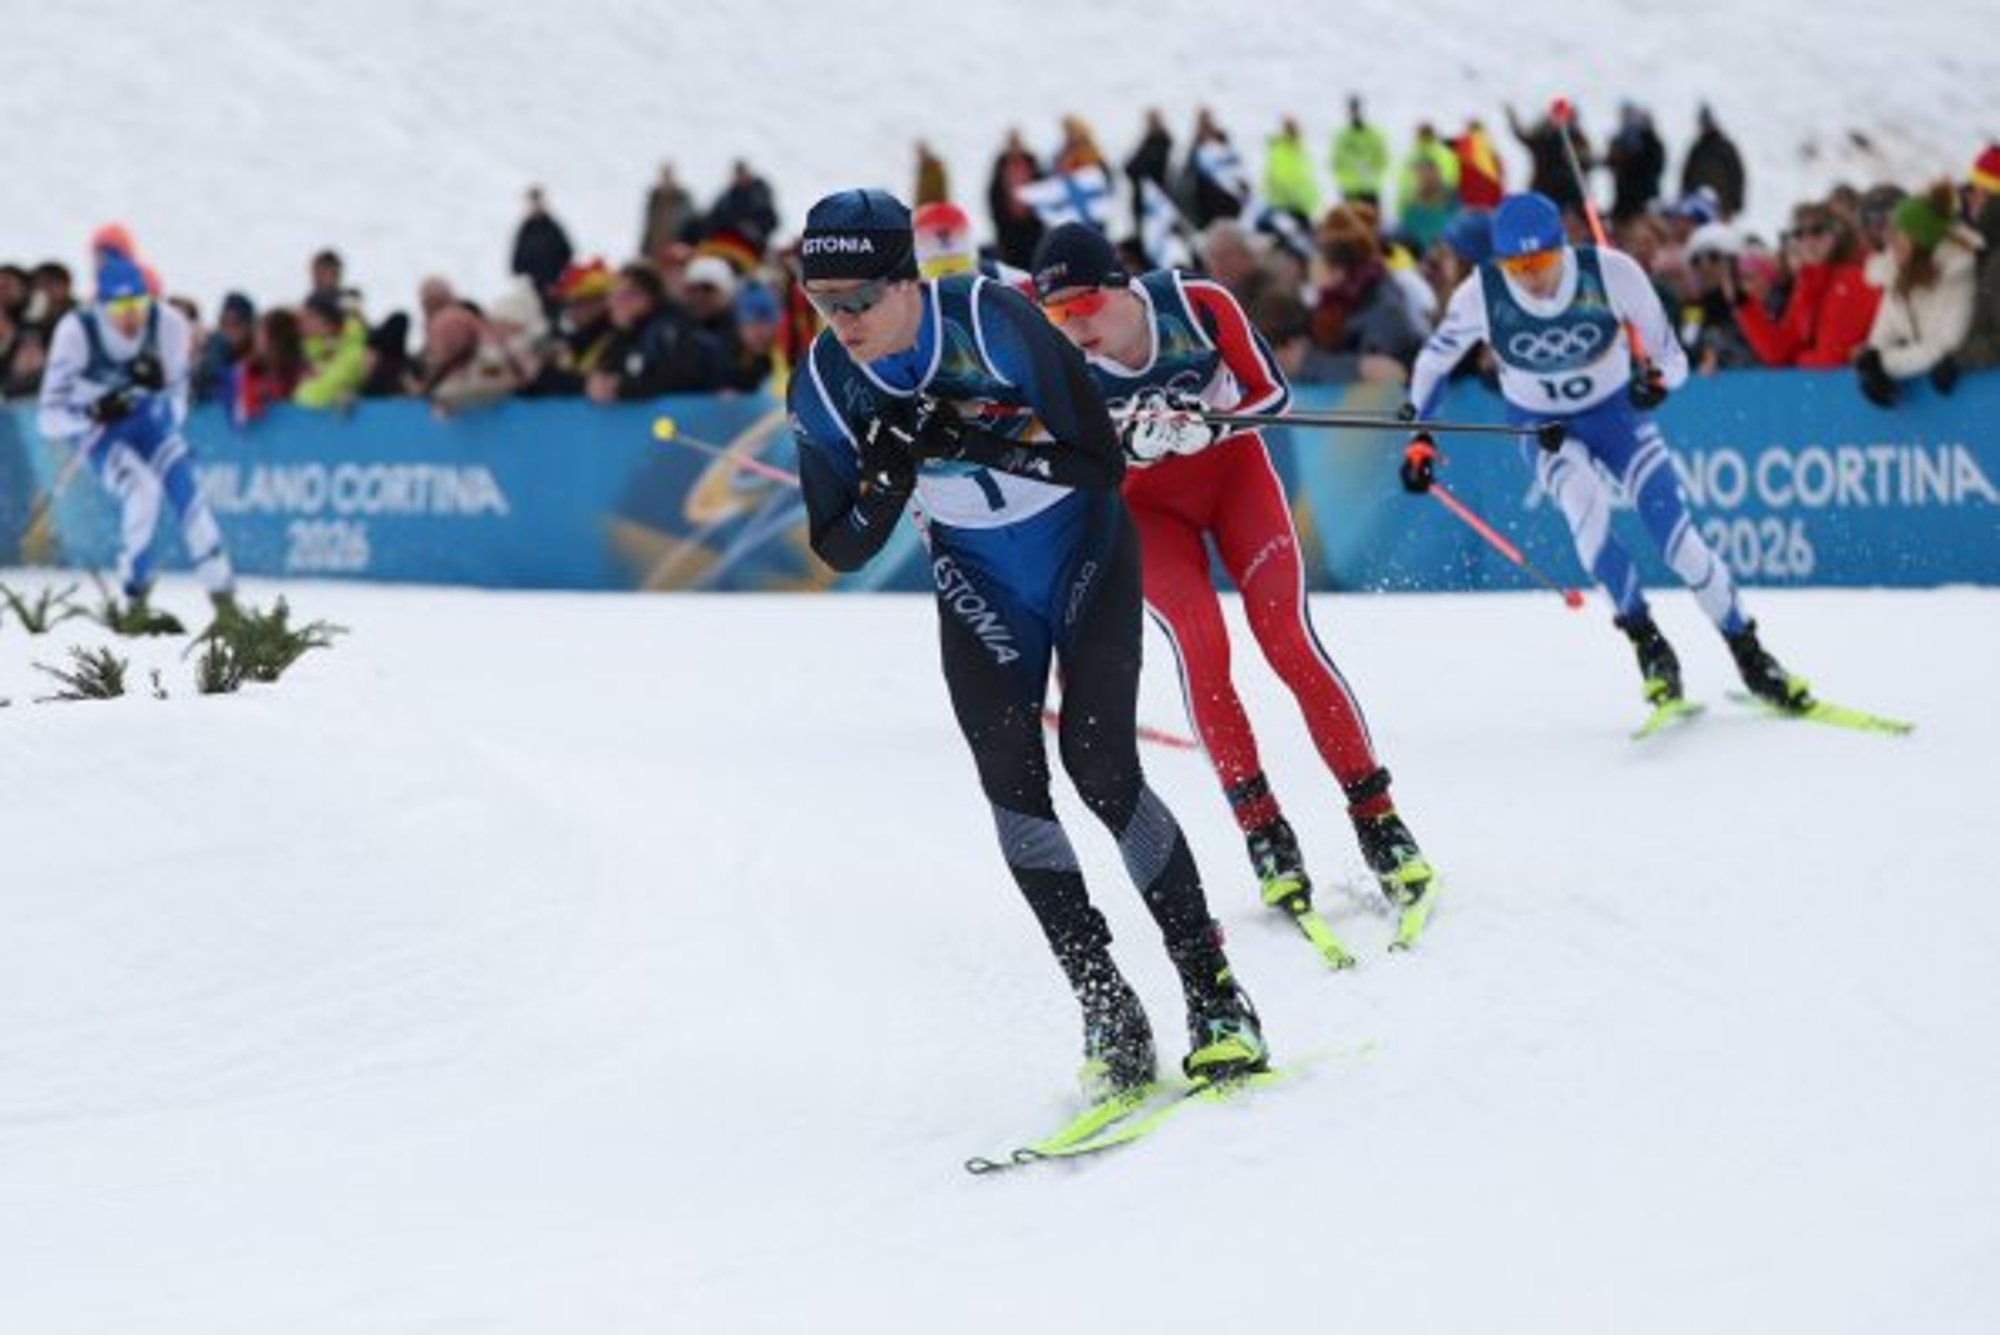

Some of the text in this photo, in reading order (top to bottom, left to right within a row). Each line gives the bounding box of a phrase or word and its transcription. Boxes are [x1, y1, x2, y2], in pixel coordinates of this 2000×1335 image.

[1539, 375, 1594, 401] 10
[1757, 443, 2000, 507] CORTINA
[1703, 516, 1815, 577] 2026
[933, 555, 1020, 664] ESTONIA
